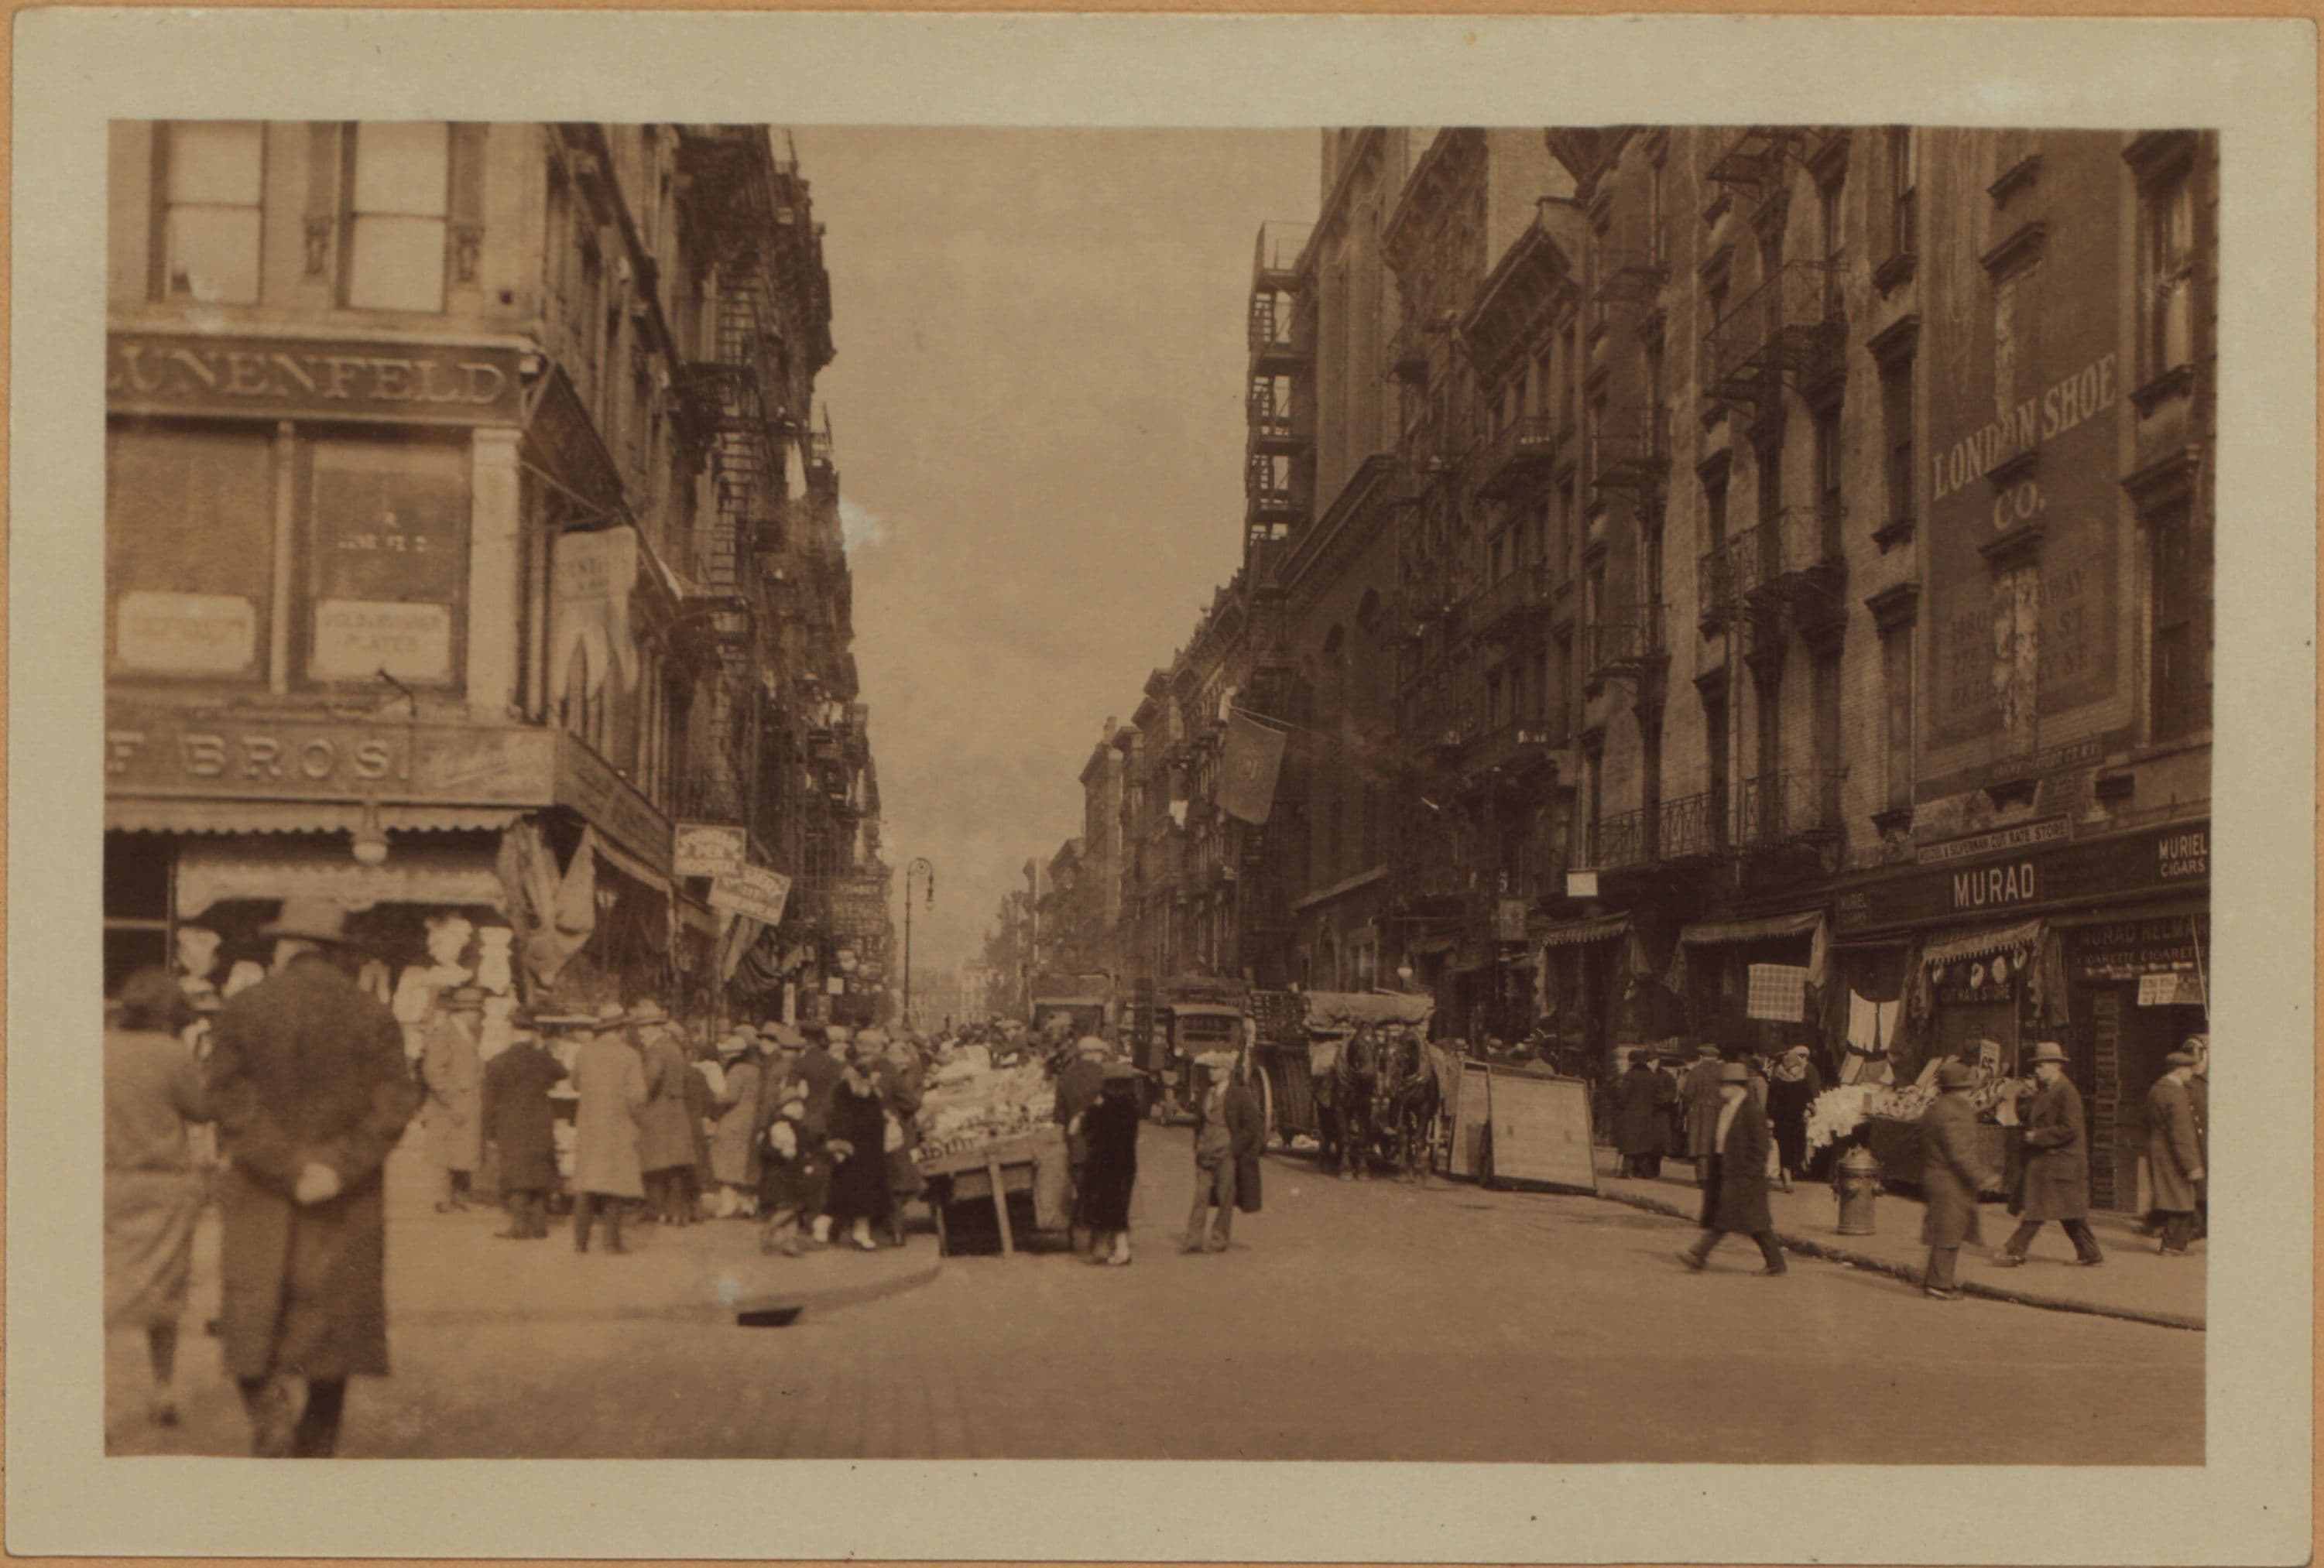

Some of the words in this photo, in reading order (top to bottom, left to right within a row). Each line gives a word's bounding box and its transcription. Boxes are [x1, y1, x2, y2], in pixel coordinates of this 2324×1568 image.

[107, 342, 507, 405] UNENFELD
[2041, 352, 2117, 441] SHOE
[1993, 481, 2046, 531] CO.
[2158, 831, 2208, 861] MURIEL
[2160, 858, 2206, 878] CIGARS
[1953, 862, 2035, 909] MURAD
